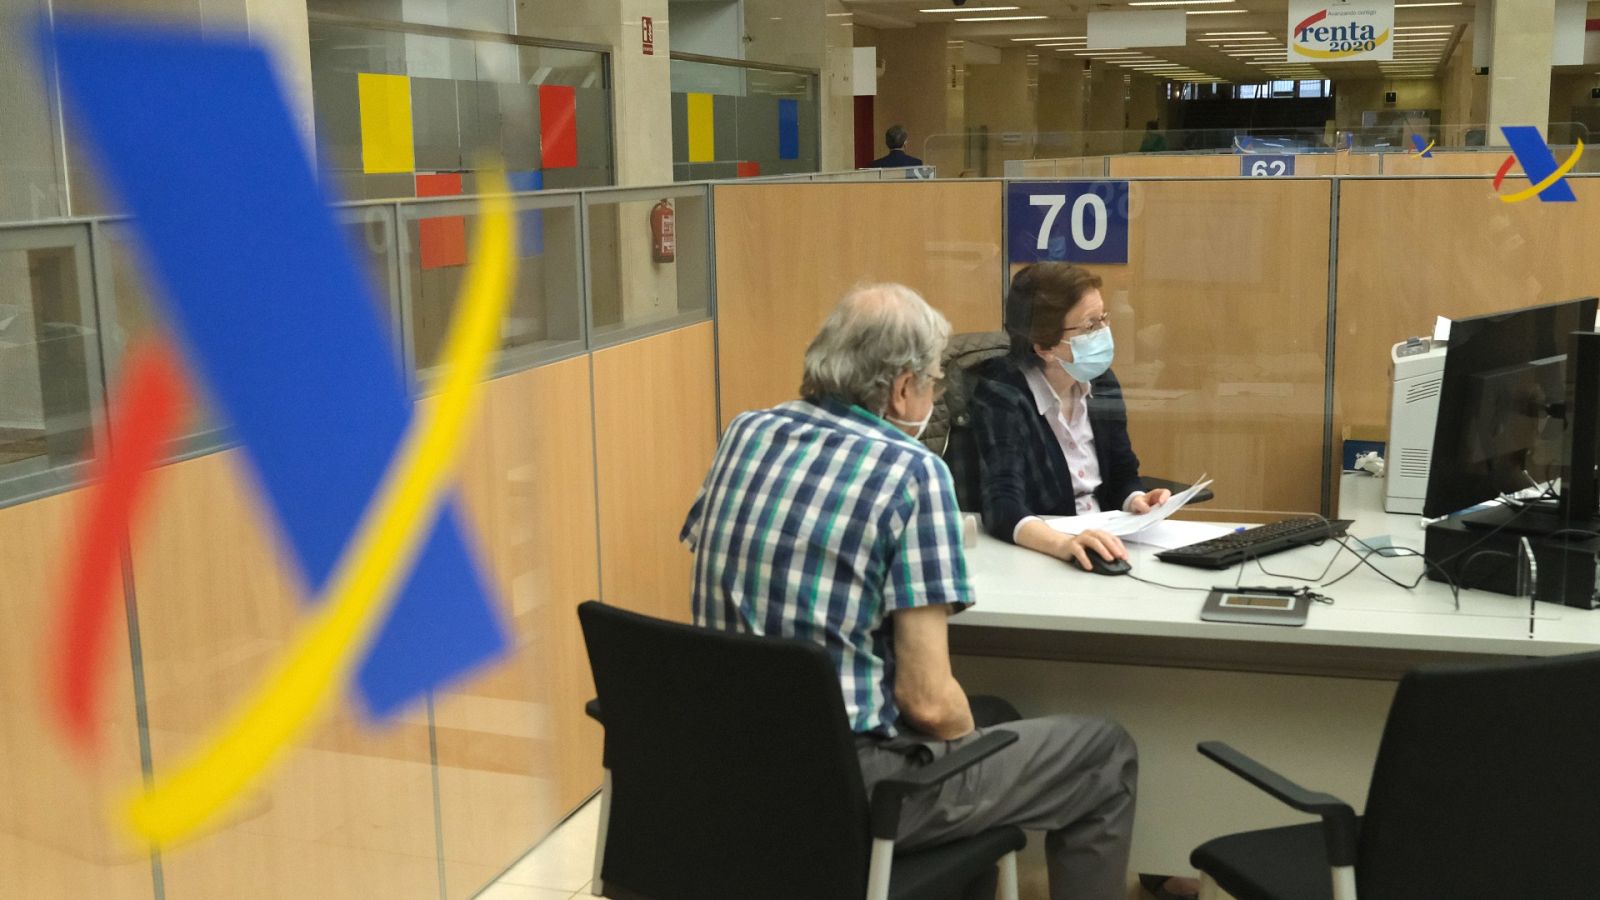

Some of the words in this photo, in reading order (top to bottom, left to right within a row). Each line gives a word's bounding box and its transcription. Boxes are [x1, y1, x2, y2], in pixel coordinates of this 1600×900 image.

[1300, 22, 1376, 42] renta
[1329, 41, 1376, 52] 2020
[1251, 160, 1286, 177] 62
[1029, 193, 1108, 251] 70
